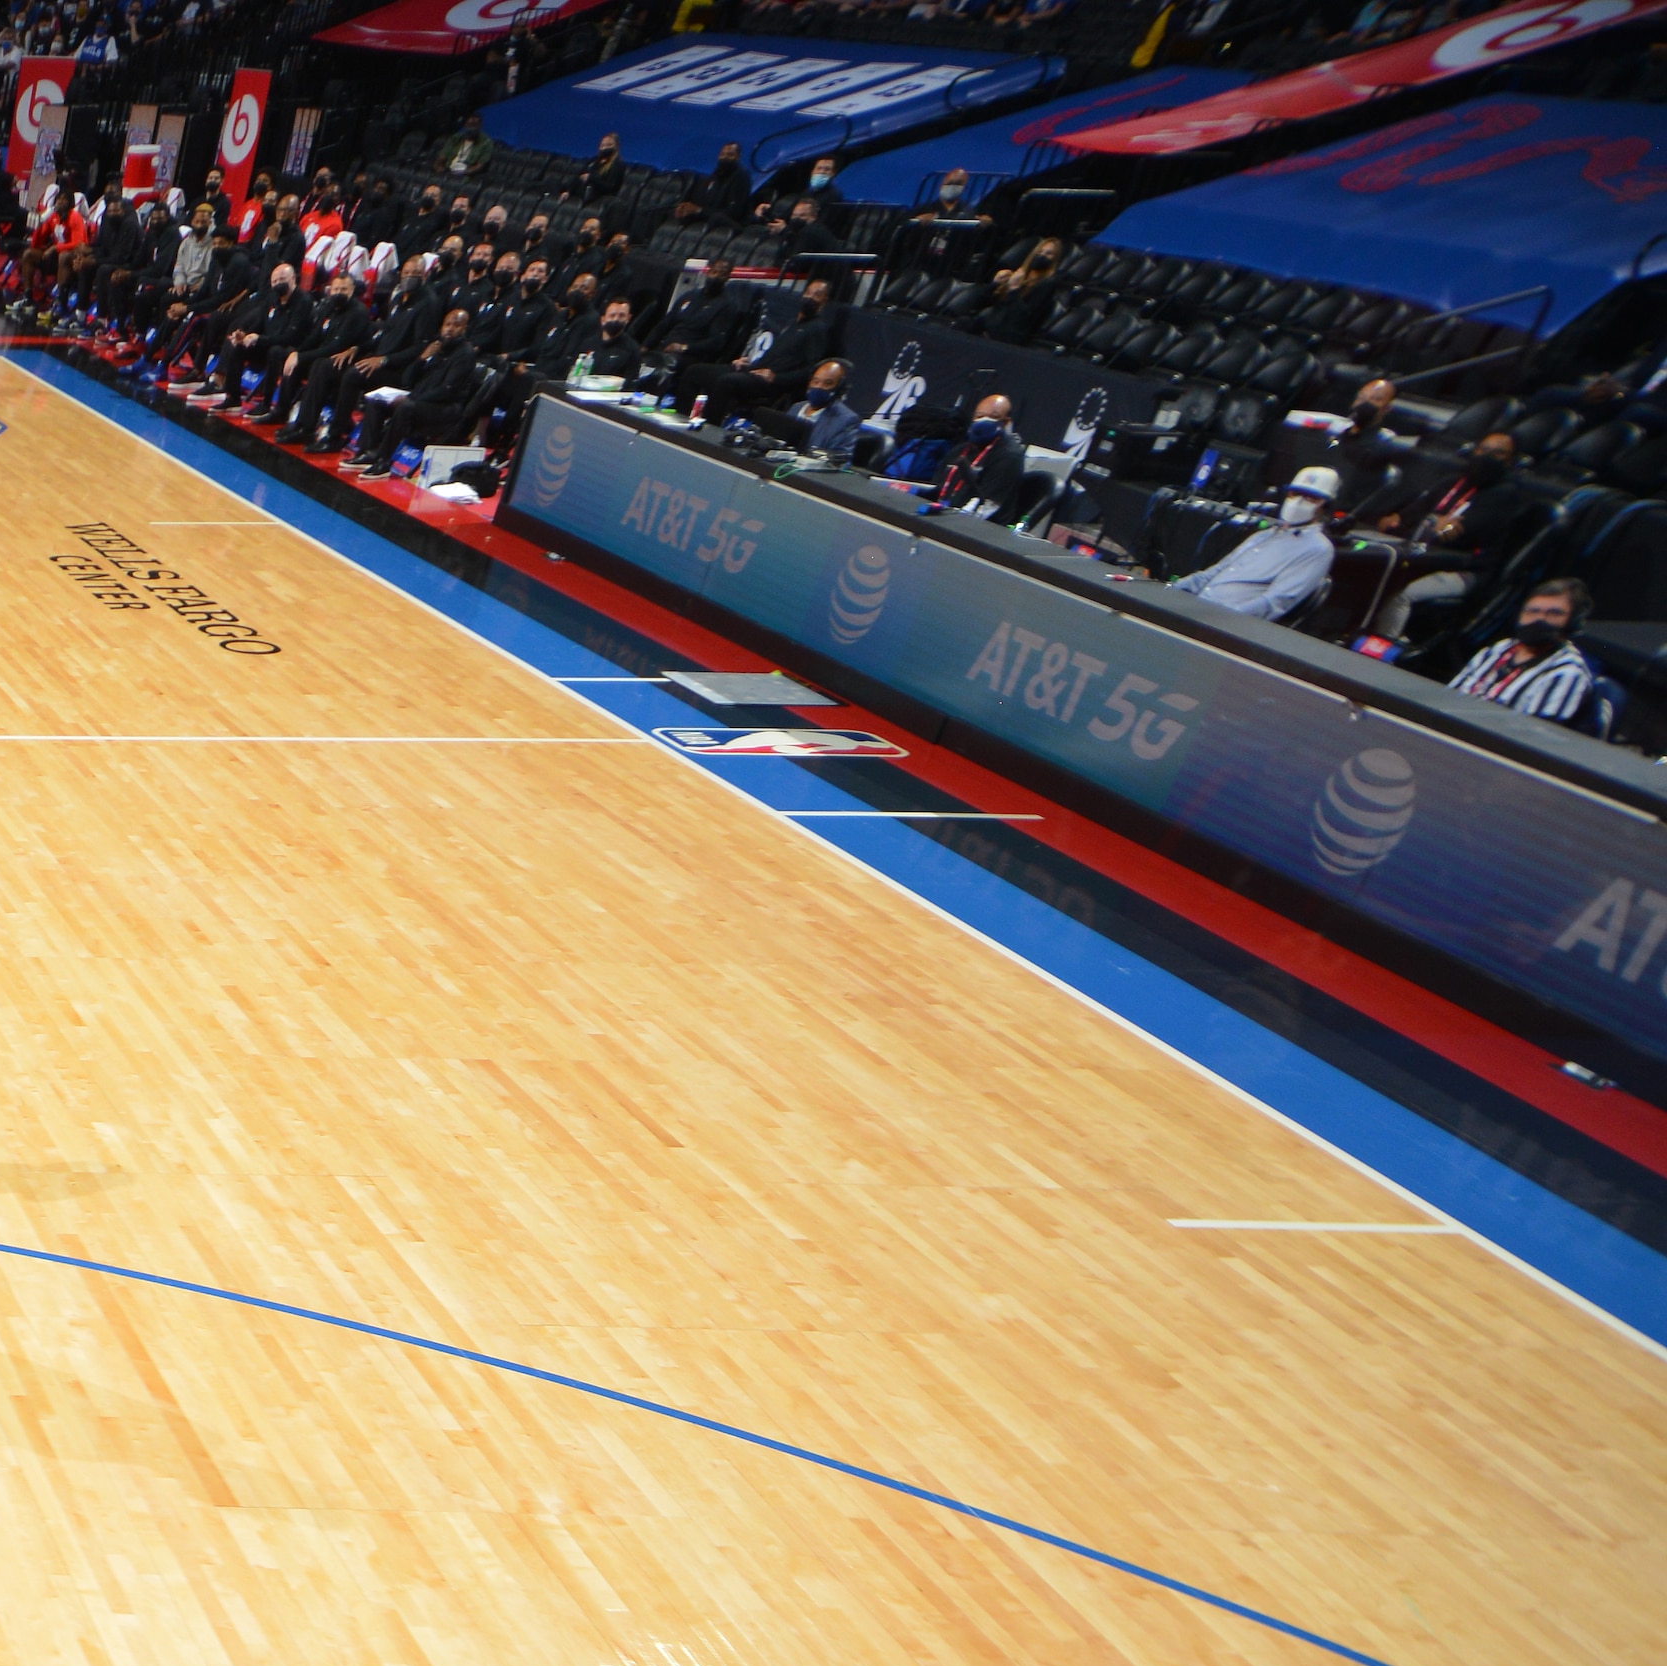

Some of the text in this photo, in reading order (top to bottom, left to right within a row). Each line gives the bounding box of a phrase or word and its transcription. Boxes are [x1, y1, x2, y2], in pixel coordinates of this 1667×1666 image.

[49, 554, 151, 610] CENTER
[620, 476, 766, 574] AT&T 5G
[65, 522, 282, 655] WELLS FARGO
[965, 621, 1201, 761] AT&T 5G
